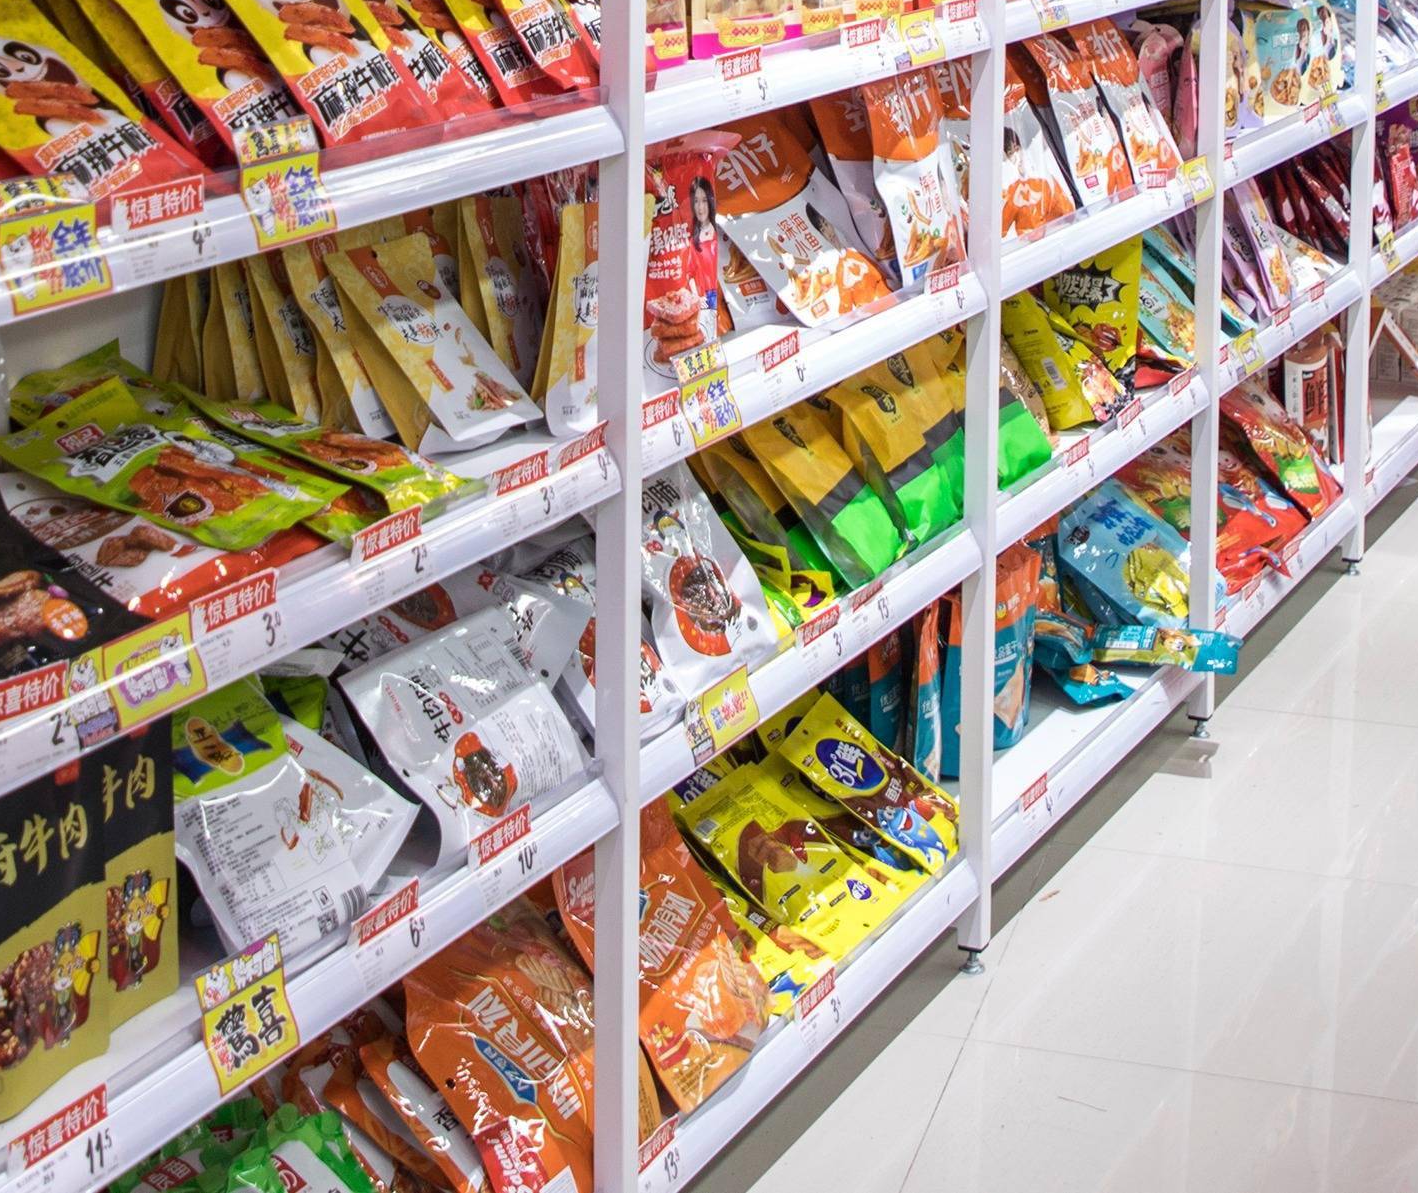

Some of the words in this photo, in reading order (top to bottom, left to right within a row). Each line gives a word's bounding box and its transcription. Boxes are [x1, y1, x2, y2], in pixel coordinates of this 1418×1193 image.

[130, 183, 204, 227] 惊喜特价!
[497, 456, 549, 495] 惊喜特价!
[363, 510, 422, 558] 惊喜特价!
[206, 579, 276, 631] 惊喜特价!
[481, 812, 531, 862] 惊喜特价!
[361, 884, 419, 944] 惊喜特价!
[214, 985, 287, 1070] 驚喜
[27, 1093, 108, 1163] 惊喜特价!
